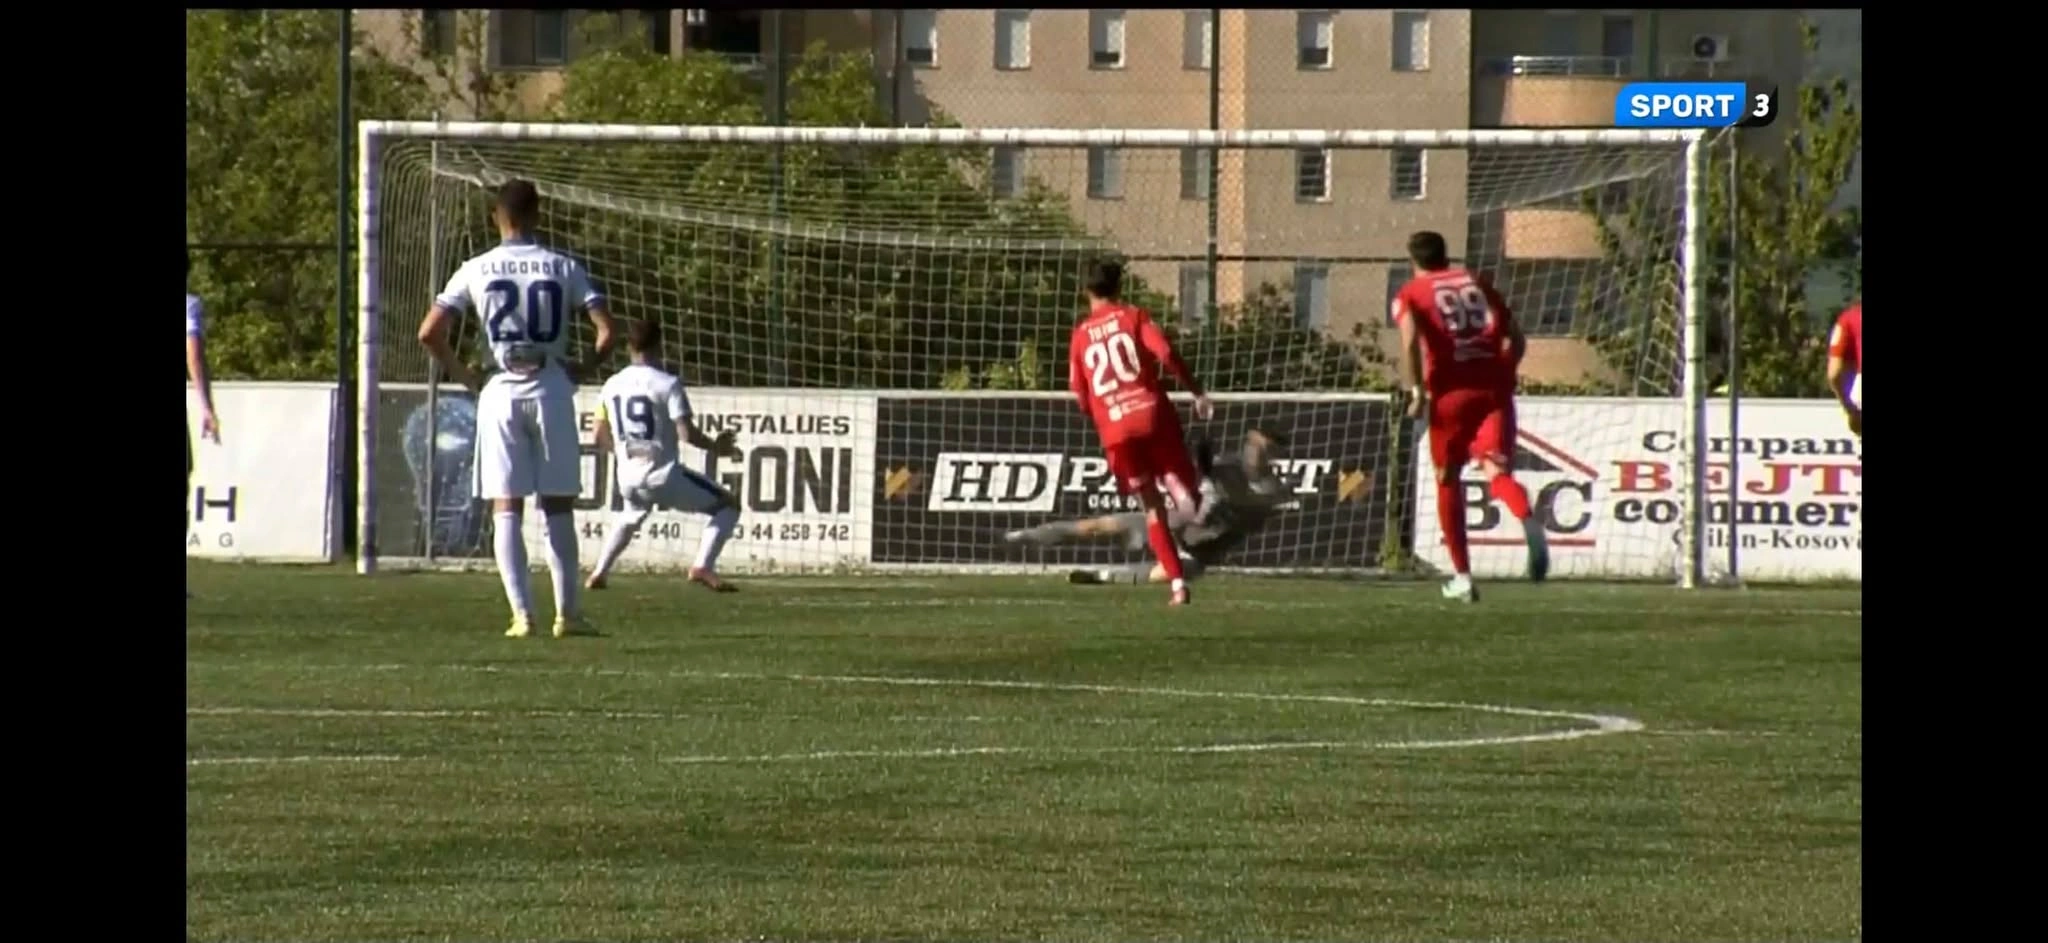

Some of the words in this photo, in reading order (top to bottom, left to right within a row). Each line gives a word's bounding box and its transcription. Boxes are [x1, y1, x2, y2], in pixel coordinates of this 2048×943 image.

[484, 279, 563, 342] 20
[1434, 285, 1487, 330] 99
[1084, 332, 1141, 397] 20
[613, 394, 655, 441] 19
[1643, 430, 1861, 460] Cmpan
[942, 460, 1048, 503] HD
[1610, 460, 1861, 496] BEJT
[649, 522, 680, 539] 440
[751, 523, 773, 540] 44
[818, 524, 849, 541] 742
